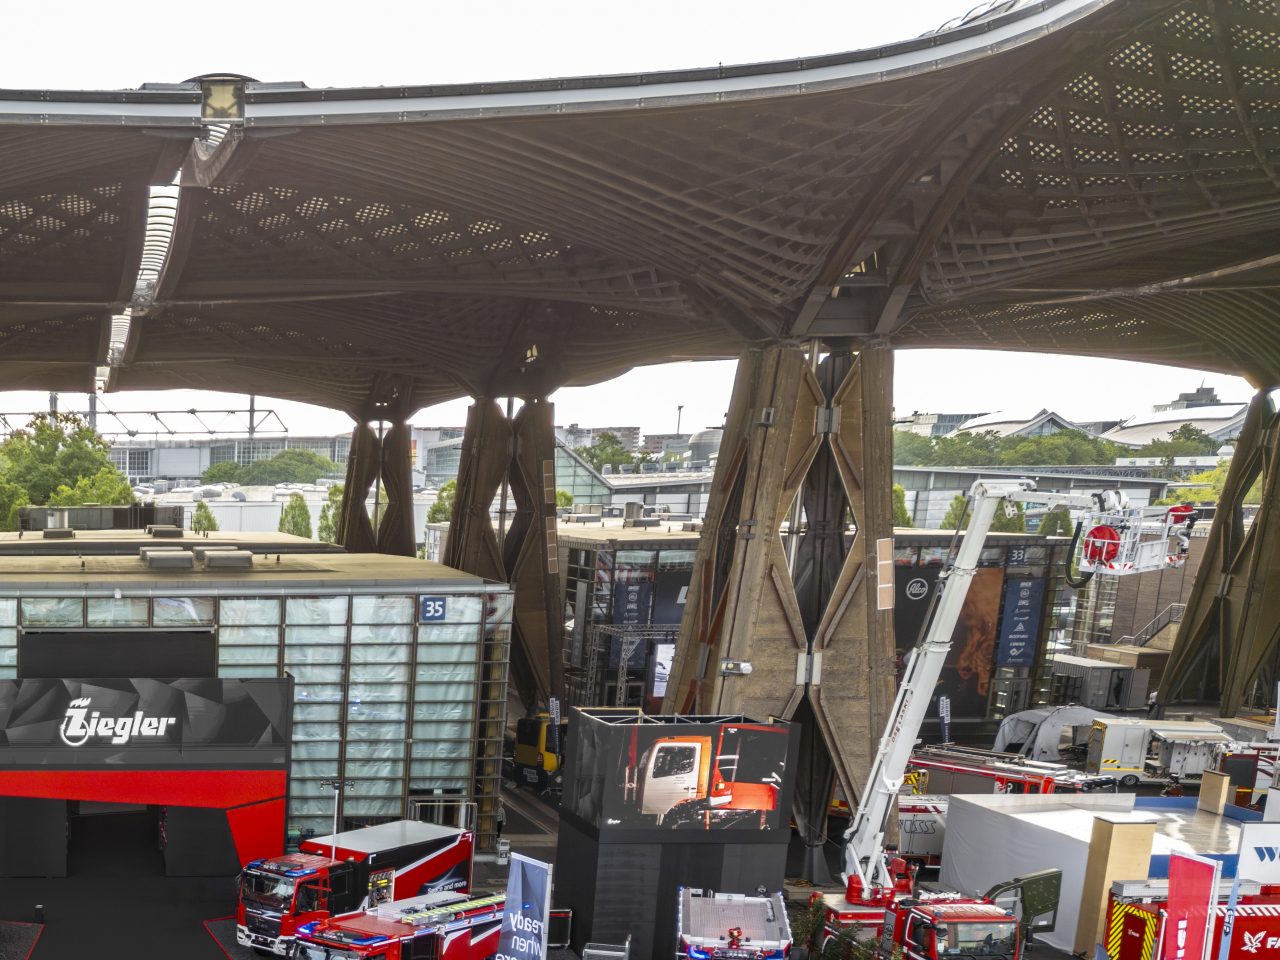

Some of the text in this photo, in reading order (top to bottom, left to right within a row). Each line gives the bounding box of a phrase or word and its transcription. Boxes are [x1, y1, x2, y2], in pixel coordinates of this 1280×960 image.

[1011, 550, 1024, 561] 33
[425, 601, 444, 617] 35
[60, 698, 176, 747] Ziegler
